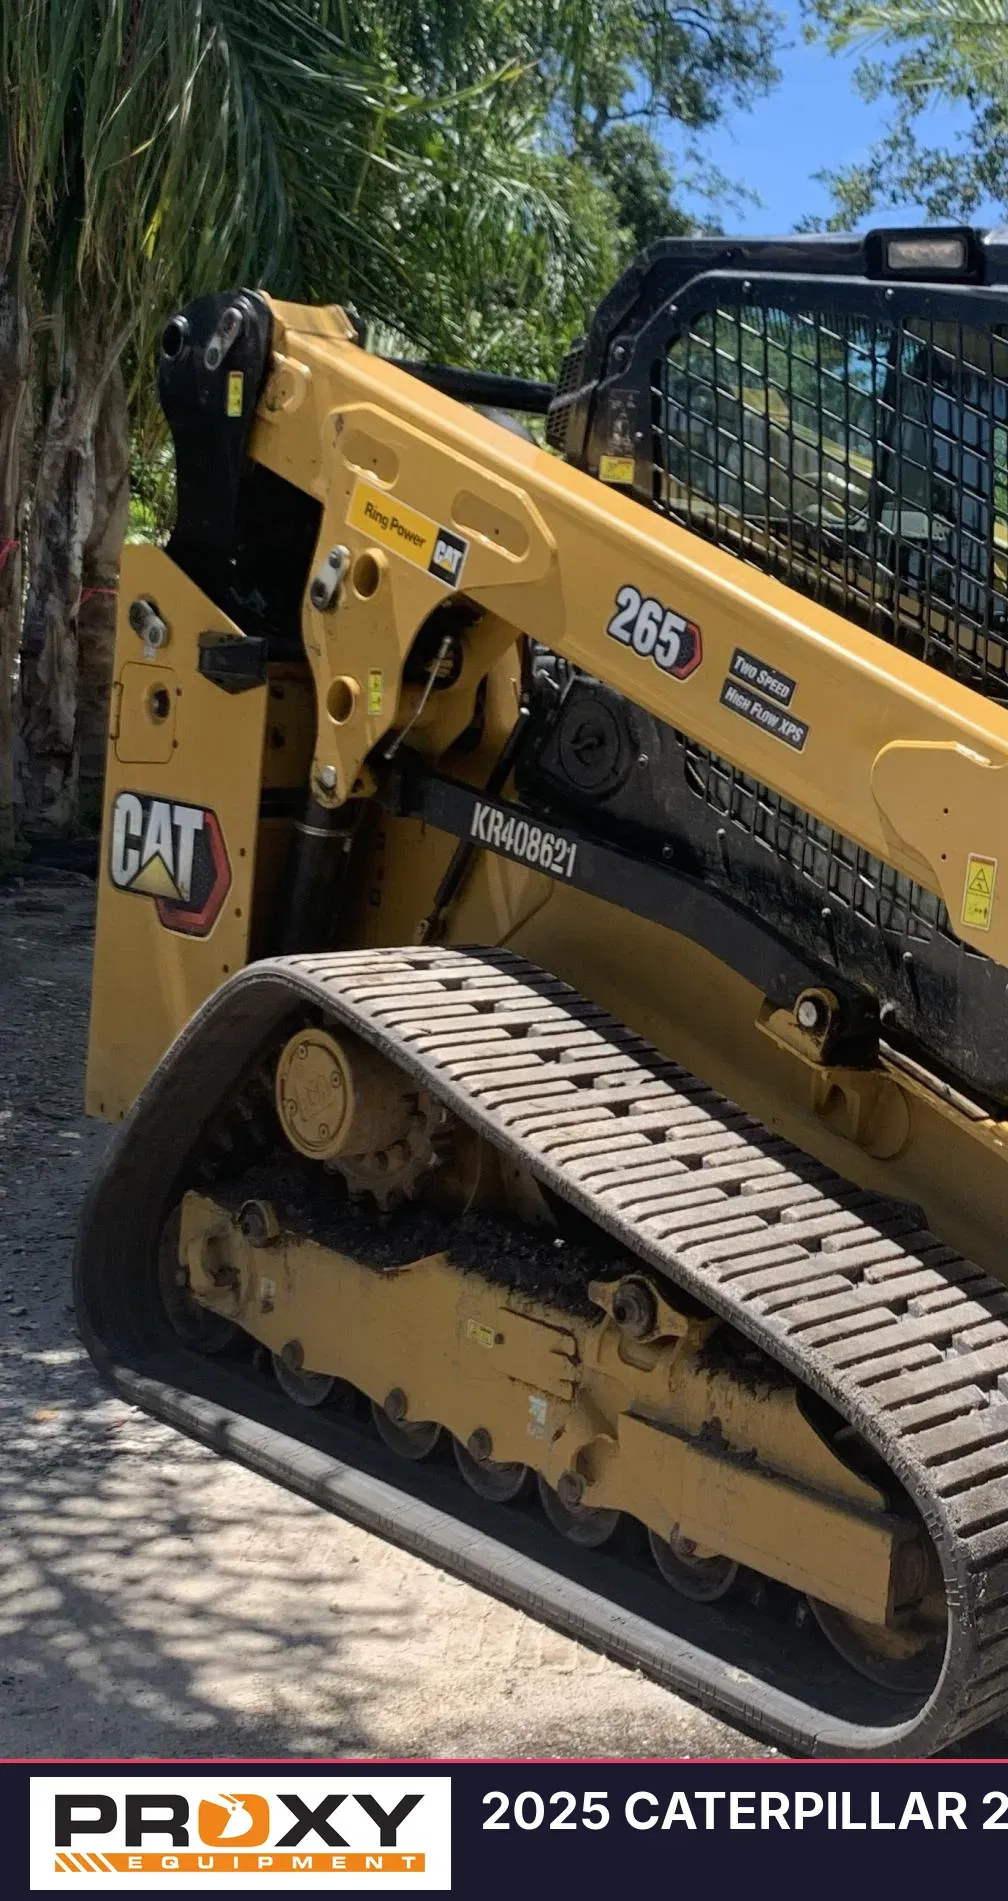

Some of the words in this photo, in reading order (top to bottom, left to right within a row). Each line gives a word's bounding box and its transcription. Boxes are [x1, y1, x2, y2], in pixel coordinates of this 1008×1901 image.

[364, 500, 390, 531] Ring
[389, 516, 427, 549] Power
[433, 539, 463, 575] CAT
[607, 586, 687, 668] 265
[756, 669, 791, 699] SPEED
[724, 686, 752, 711] HIGH
[749, 702, 780, 728] FLOW
[777, 718, 804, 743] XPS
[111, 792, 205, 902] CAT
[470, 801, 577, 878] KR408621
